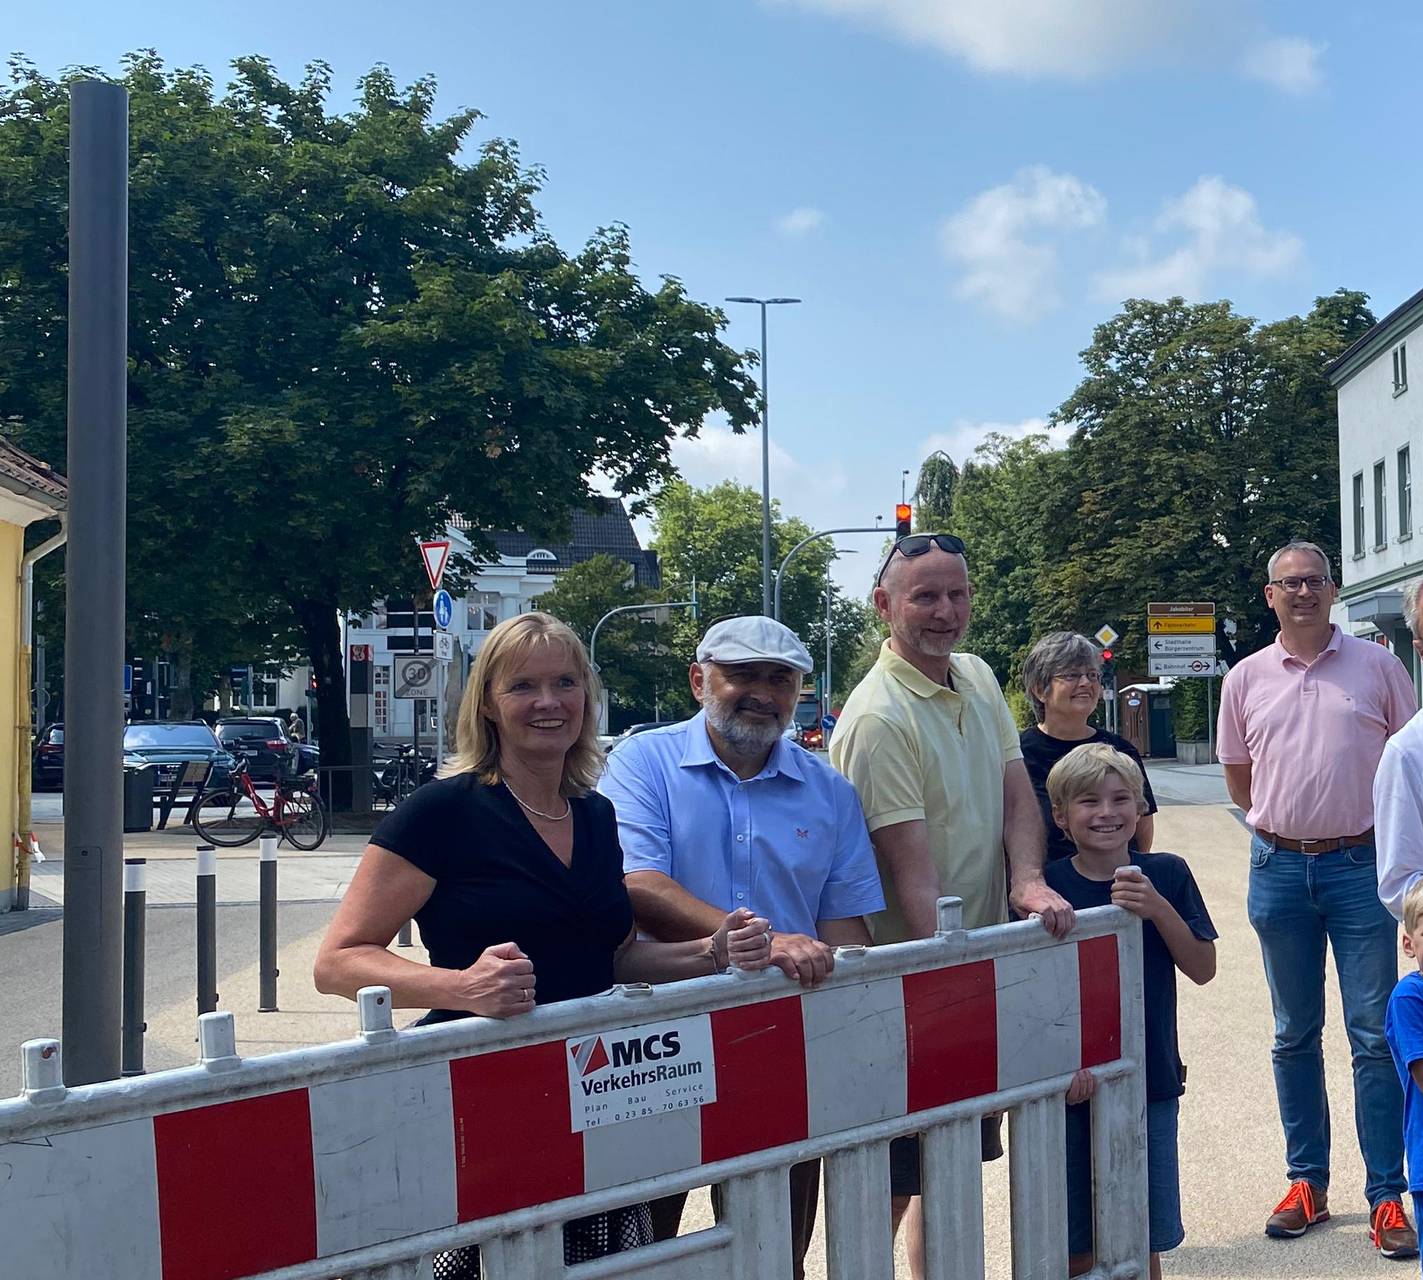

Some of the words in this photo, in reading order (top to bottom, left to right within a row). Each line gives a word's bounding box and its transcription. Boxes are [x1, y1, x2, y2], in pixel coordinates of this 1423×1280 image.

[408, 667, 426, 680] 30
[406, 688, 428, 696] ZONE
[612, 1031, 681, 1068] MCS
[581, 1060, 703, 1096] VerkehrsRaum
[585, 1104, 608, 1113] Plan
[627, 1096, 647, 1105] Bau
[665, 1083, 704, 1097] Service
